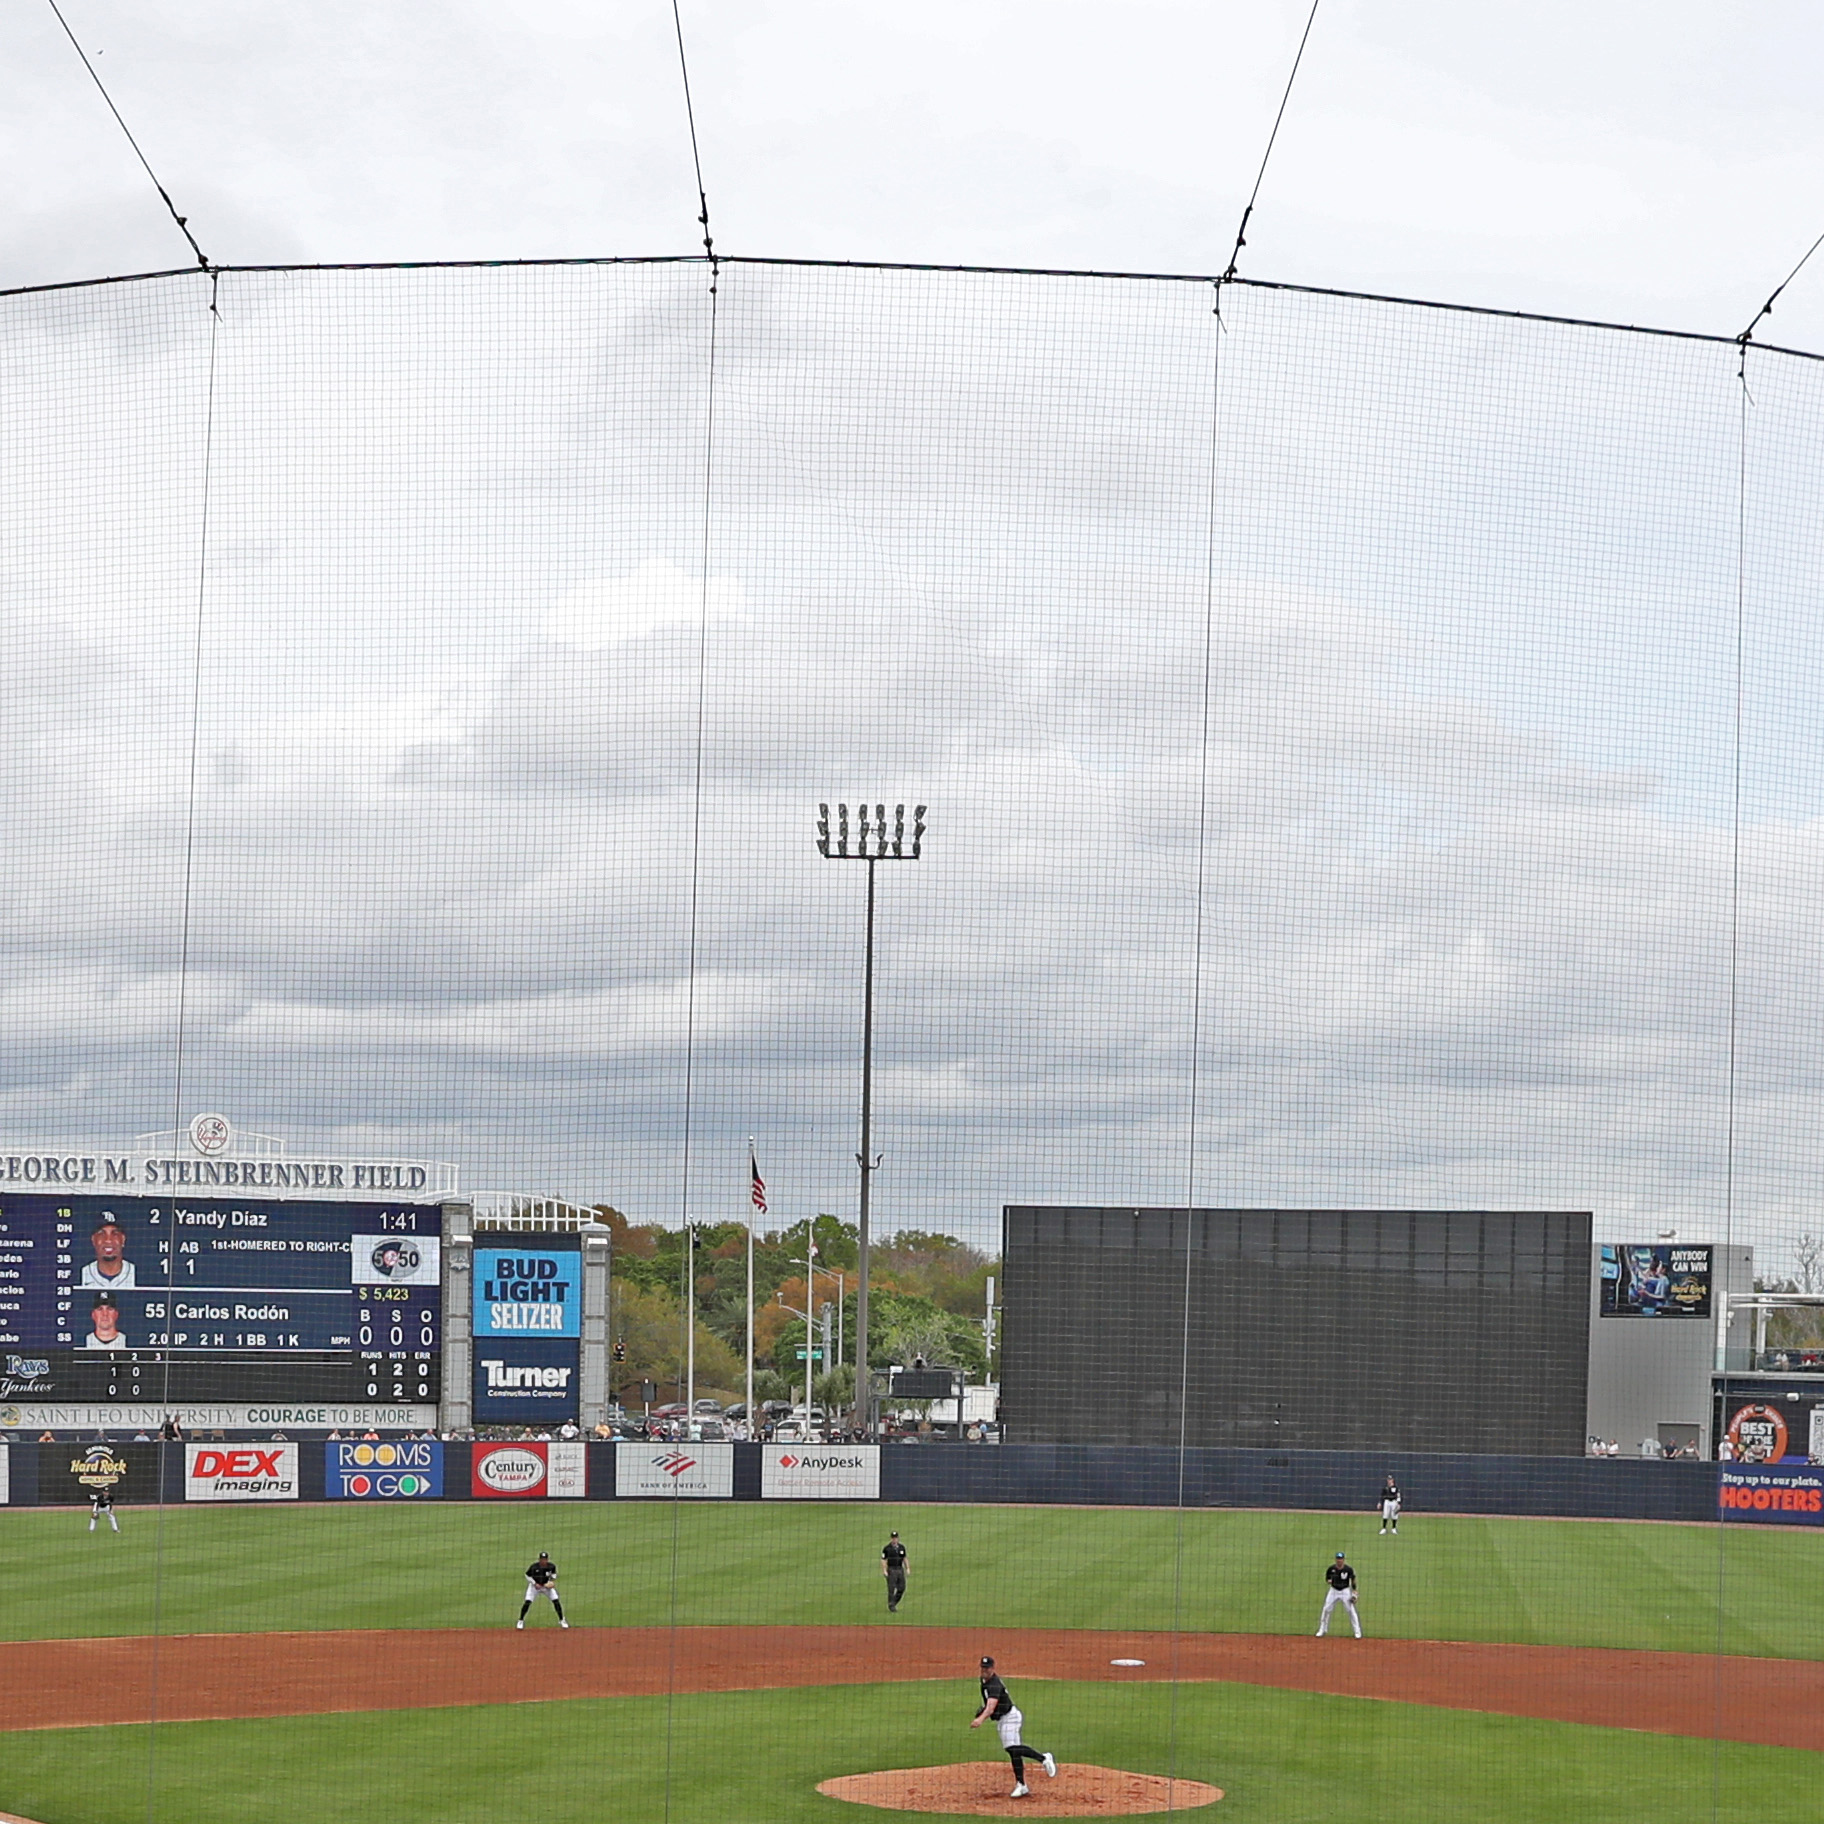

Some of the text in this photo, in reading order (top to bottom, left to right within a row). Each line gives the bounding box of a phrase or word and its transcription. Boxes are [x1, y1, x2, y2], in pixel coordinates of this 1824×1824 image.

[104, 1158, 135, 1183] M.
[145, 1159, 344, 1188] STEINBRENNER
[352, 1165, 427, 1189] FIELD
[149, 1209, 268, 1229] 2 Yandy Díaz
[379, 1211, 417, 1230] 1:41
[56, 1223, 72, 1233] DH
[179, 1241, 200, 1253] AB
[211, 1240, 304, 1251] 1st-HOMERED TO
[1670, 1250, 1708, 1261] ANYBODY
[496, 1258, 558, 1280] BUD
[1672, 1262, 1708, 1272] CAN WIN
[374, 1288, 409, 1301] 5,423
[484, 1280, 570, 1302] LIGHT
[145, 1303, 289, 1320] 55 Carlos Rodón
[490, 1303, 563, 1330] SELTZER
[359, 1326, 403, 1346] 0 0
[480, 1360, 572, 1387] Turner
[0, 1378, 56, 1399] Yankees
[487, 1389, 567, 1399] Construction Company
[27, 1408, 81, 1424] SAINT
[87, 1408, 122, 1424] LEO
[247, 1409, 326, 1423] COURAGE
[330, 1409, 348, 1423] TO
[353, 1409, 371, 1423] BE
[375, 1409, 418, 1424] MORE.
[1740, 1422, 1775, 1434] BEST
[339, 1443, 431, 1466] ROOMS
[801, 1454, 864, 1470] AnyDesk
[71, 1459, 127, 1475] Hard Rock
[192, 1450, 285, 1478] DEX
[484, 1459, 538, 1480] Century
[340, 1474, 419, 1497] TO GO
[497, 1473, 528, 1482] TAMPA
[1722, 1473, 1823, 1488] Step up our plate.
[214, 1478, 293, 1494] imaging
[673, 1482, 708, 1490] AMERICA
[1719, 1486, 1823, 1513] HOOTERS
